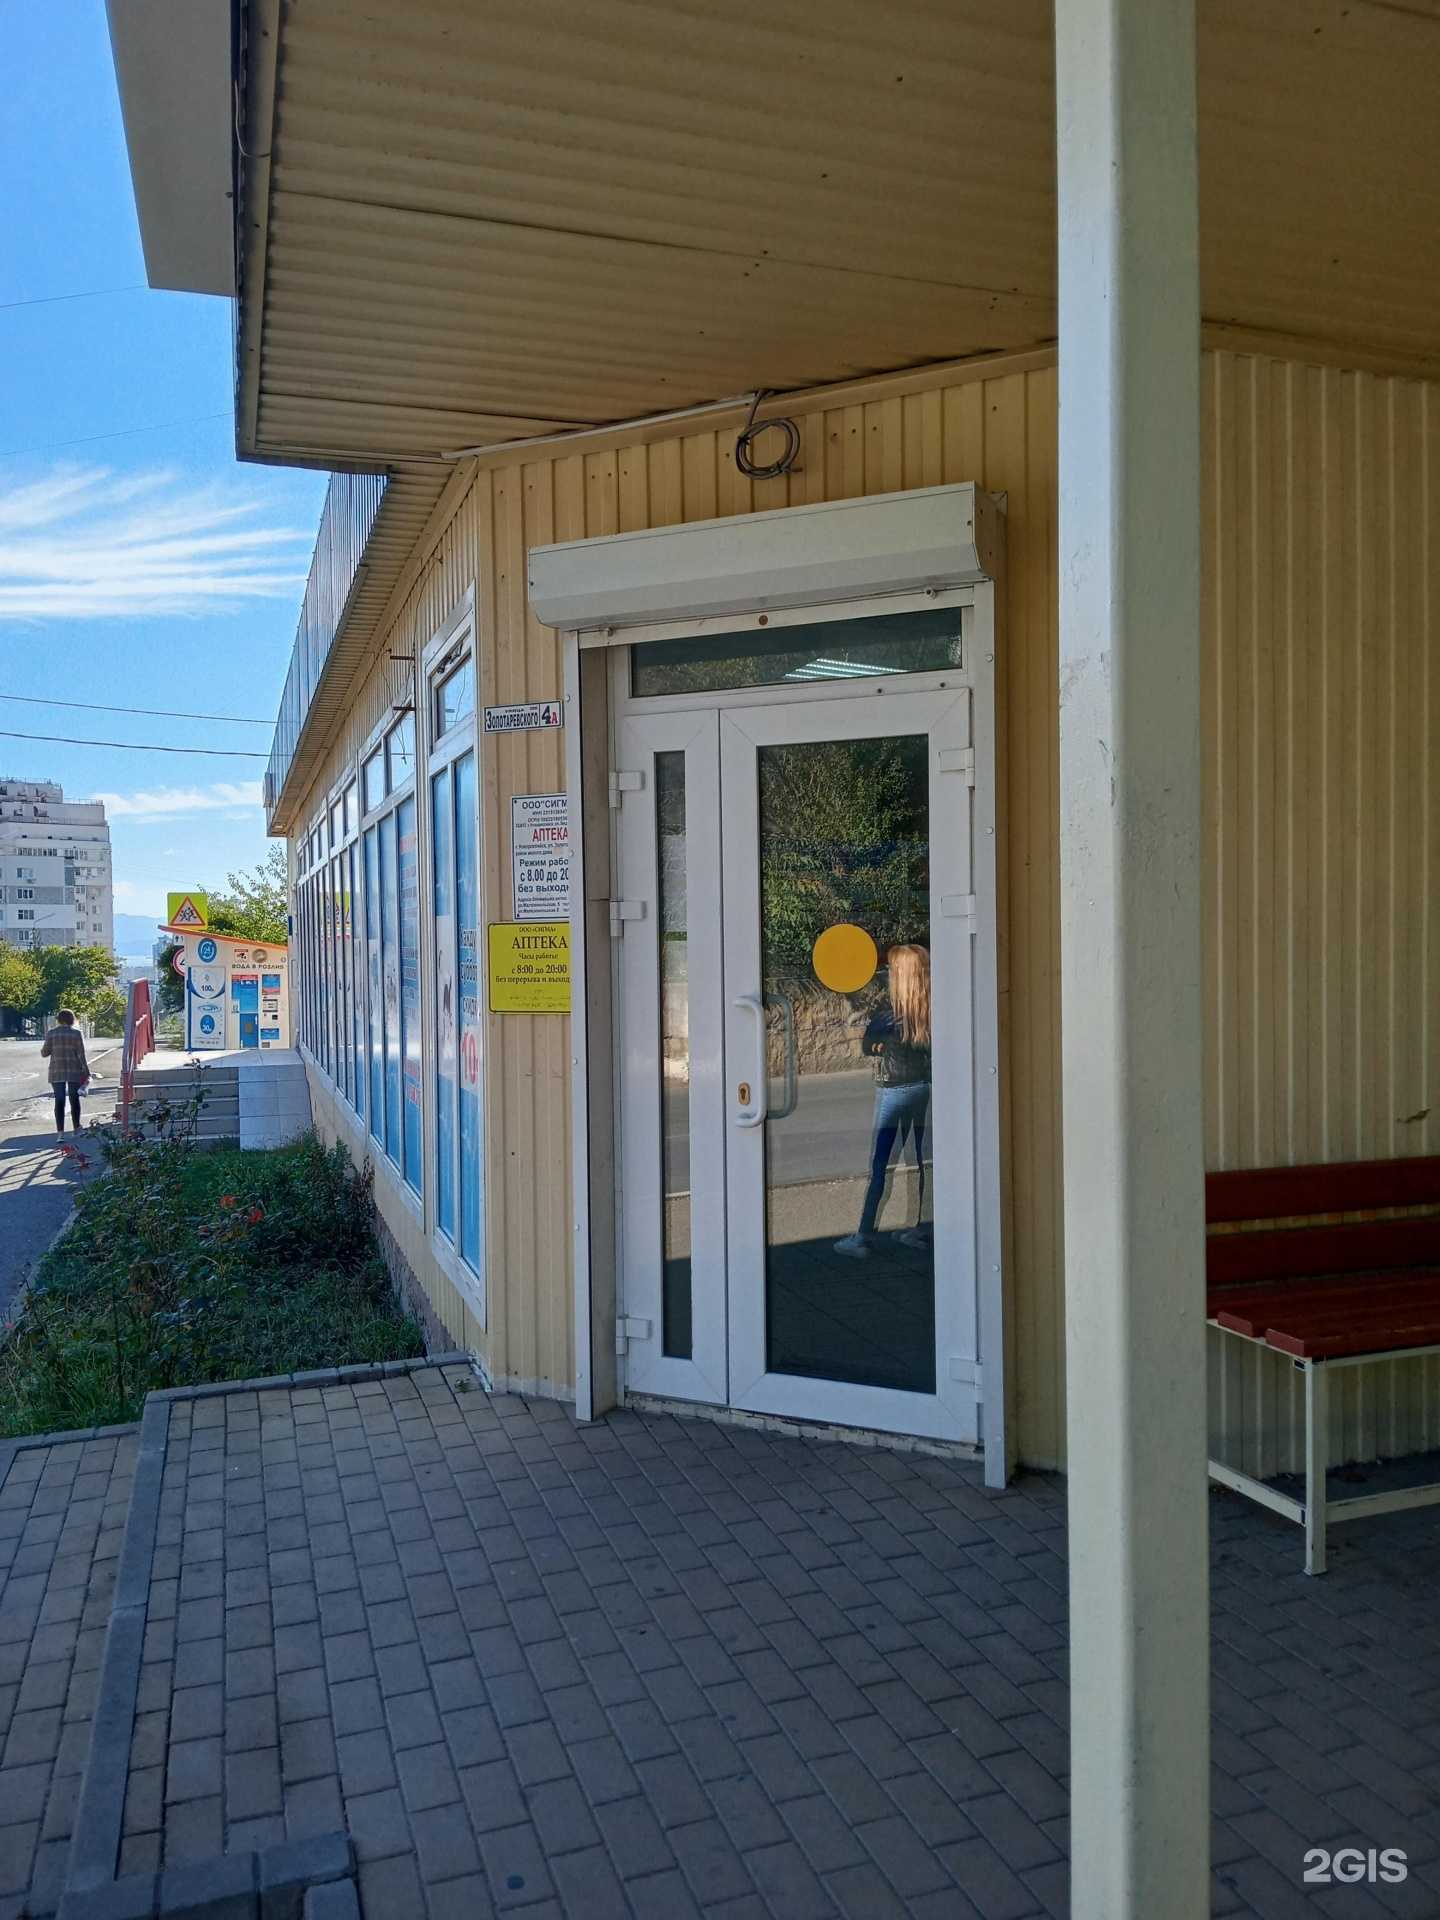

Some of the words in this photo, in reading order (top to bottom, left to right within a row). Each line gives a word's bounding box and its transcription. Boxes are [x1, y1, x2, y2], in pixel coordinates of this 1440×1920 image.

[532, 827, 568, 842] АПТЕКА
[519, 858, 547, 867] Режим
[520, 872, 526, 882] с
[546, 871, 558, 883] до
[518, 884, 534, 893] без
[512, 935, 569, 949] АПТЕКА
[516, 964, 534, 974] 8:00
[545, 963, 567, 974] 20:00
